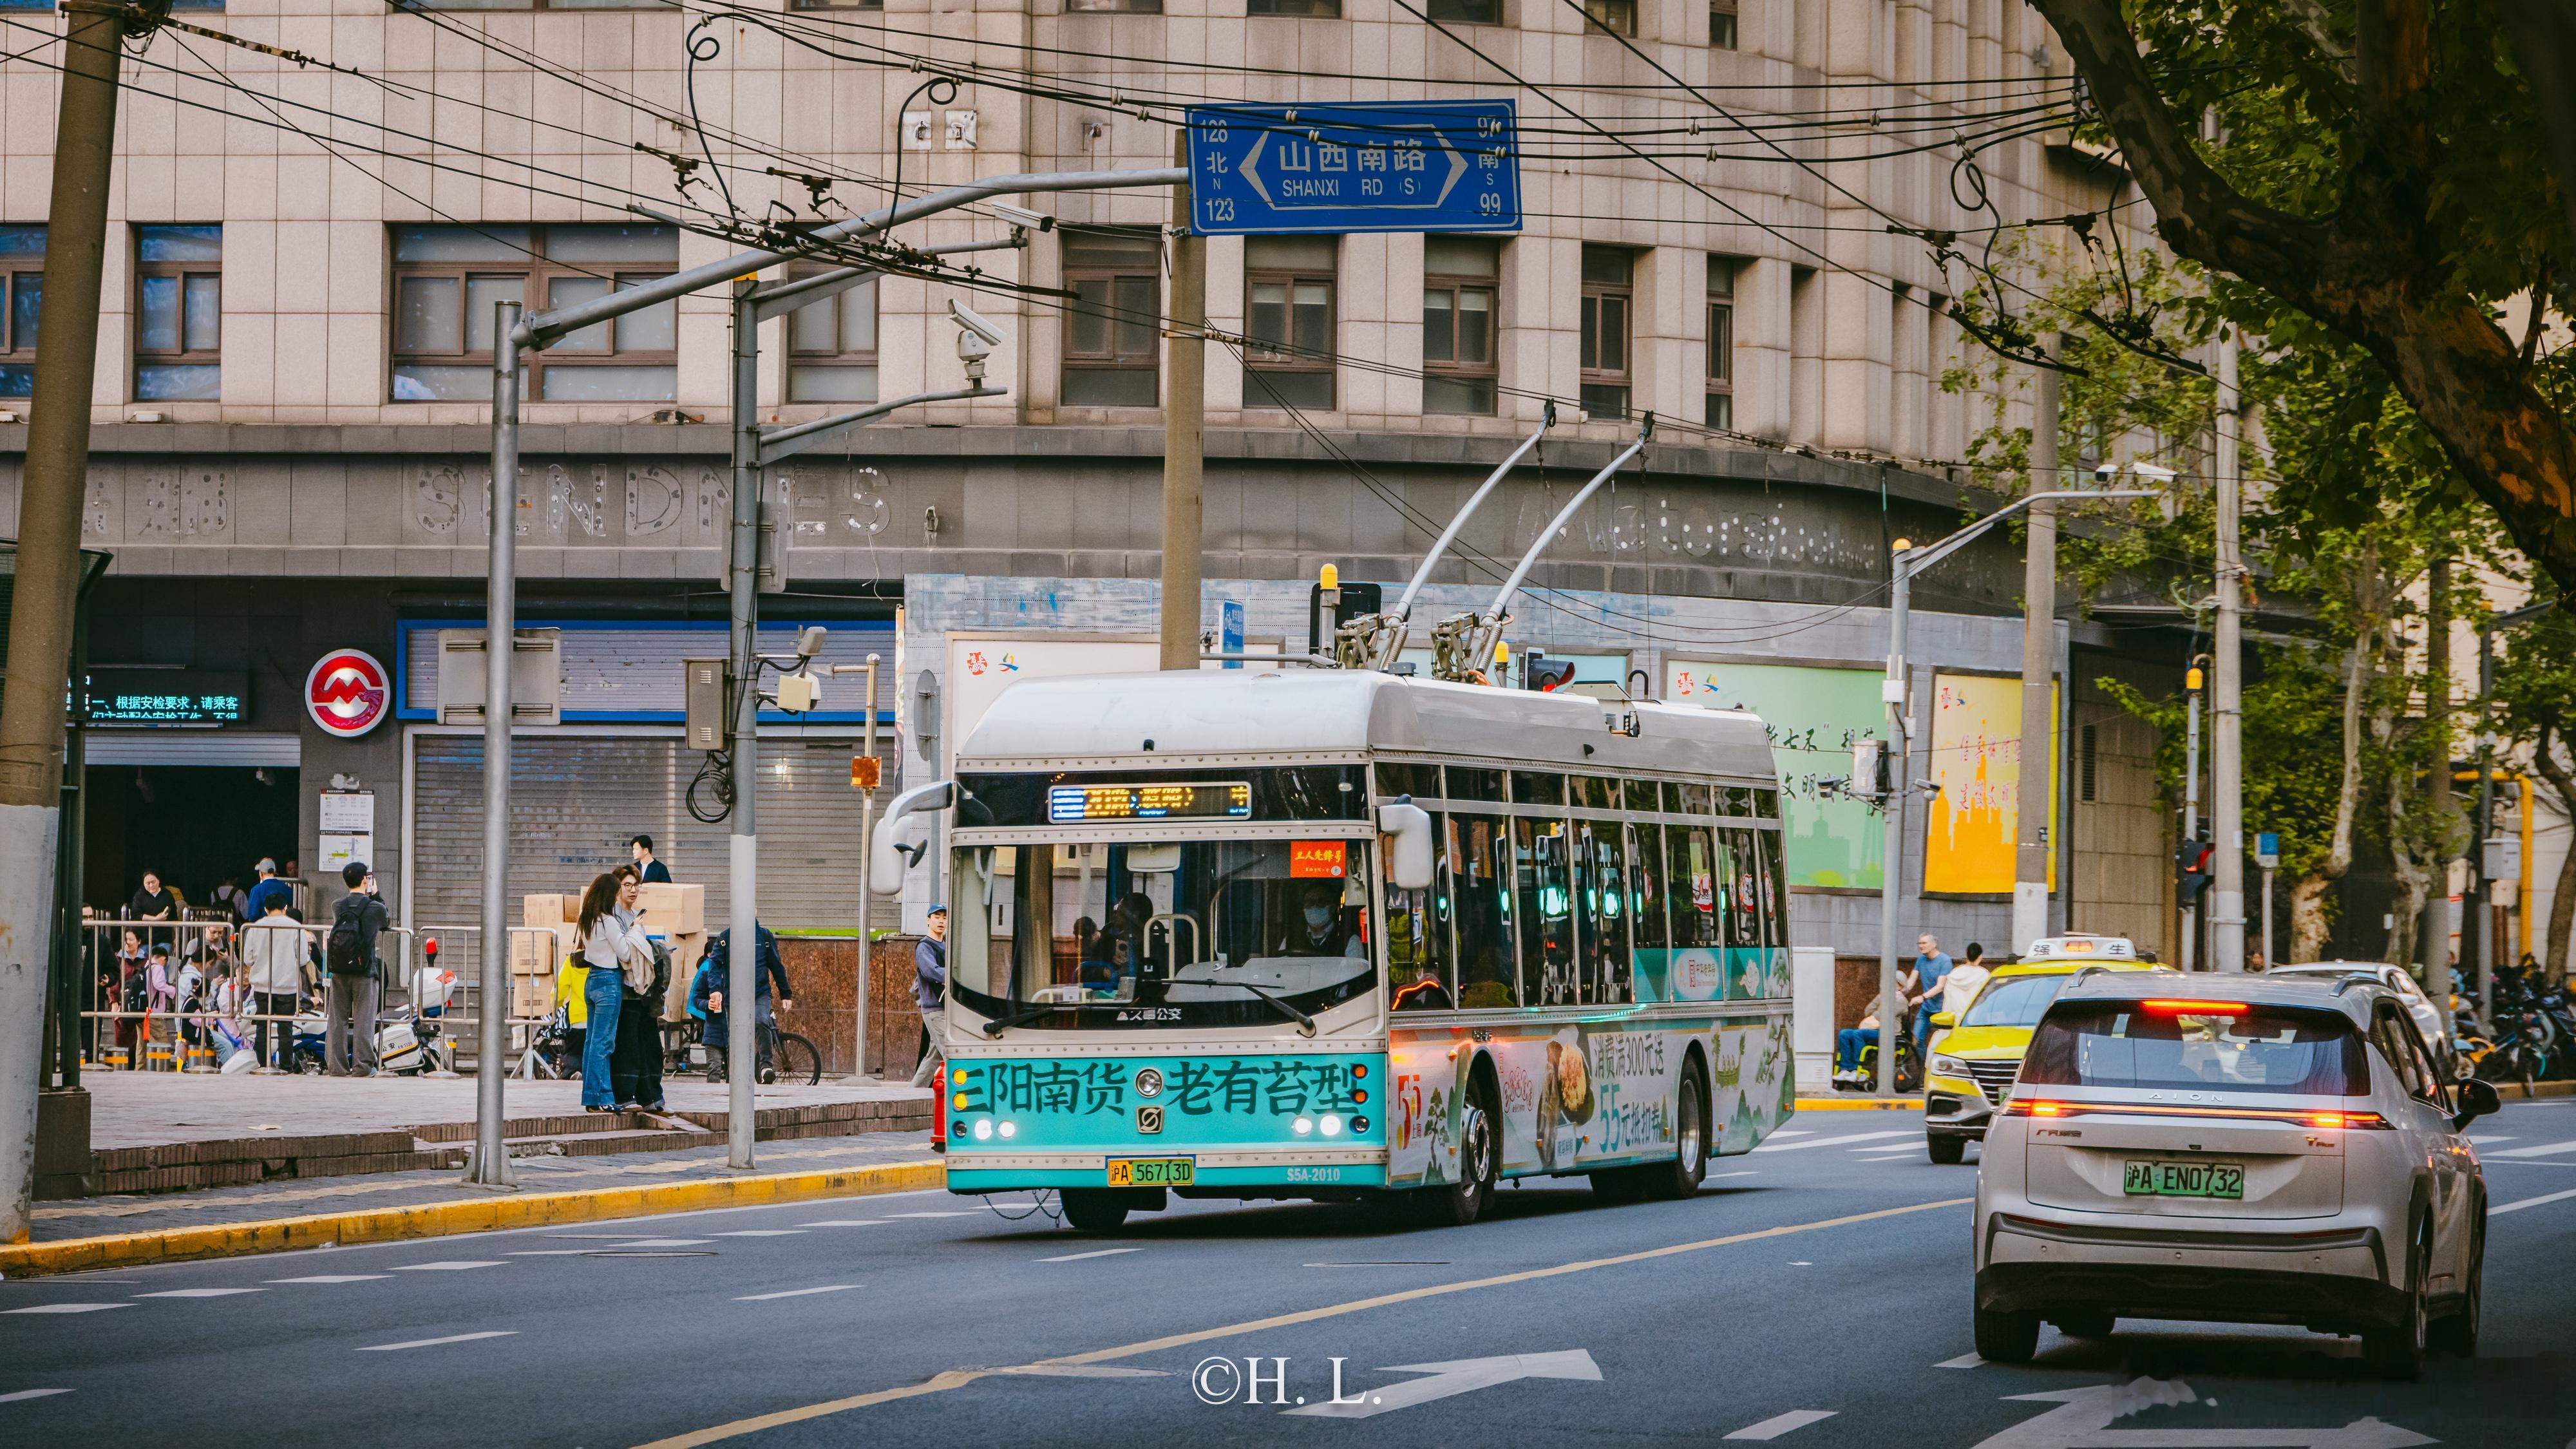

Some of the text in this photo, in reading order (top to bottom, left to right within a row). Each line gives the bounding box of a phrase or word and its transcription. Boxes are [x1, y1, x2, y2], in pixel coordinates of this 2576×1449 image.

[1206, 151, 1228, 174] 北
[1280, 138, 1426, 172] 山西南路
[1479, 147, 1499, 169] 南
[1213, 178, 1221, 190] N
[1282, 178, 1340, 197] SHANXI
[1361, 178, 1383, 196] RD
[1486, 173, 1494, 185] S
[1206, 197, 1235, 222] 123
[1480, 193, 1501, 217] 99
[2034, 944, 2126, 956] 强 生
[1594, 1032, 1664, 1079] 消费满300元送
[1164, 1060, 1359, 1116] 老有苔型
[2148, 1092, 2223, 1102] AION
[1137, 1163, 1190, 1181] 56713D
[1287, 1168, 1340, 1182] S5A-2010
[2163, 1166, 2241, 1193] EN0732
